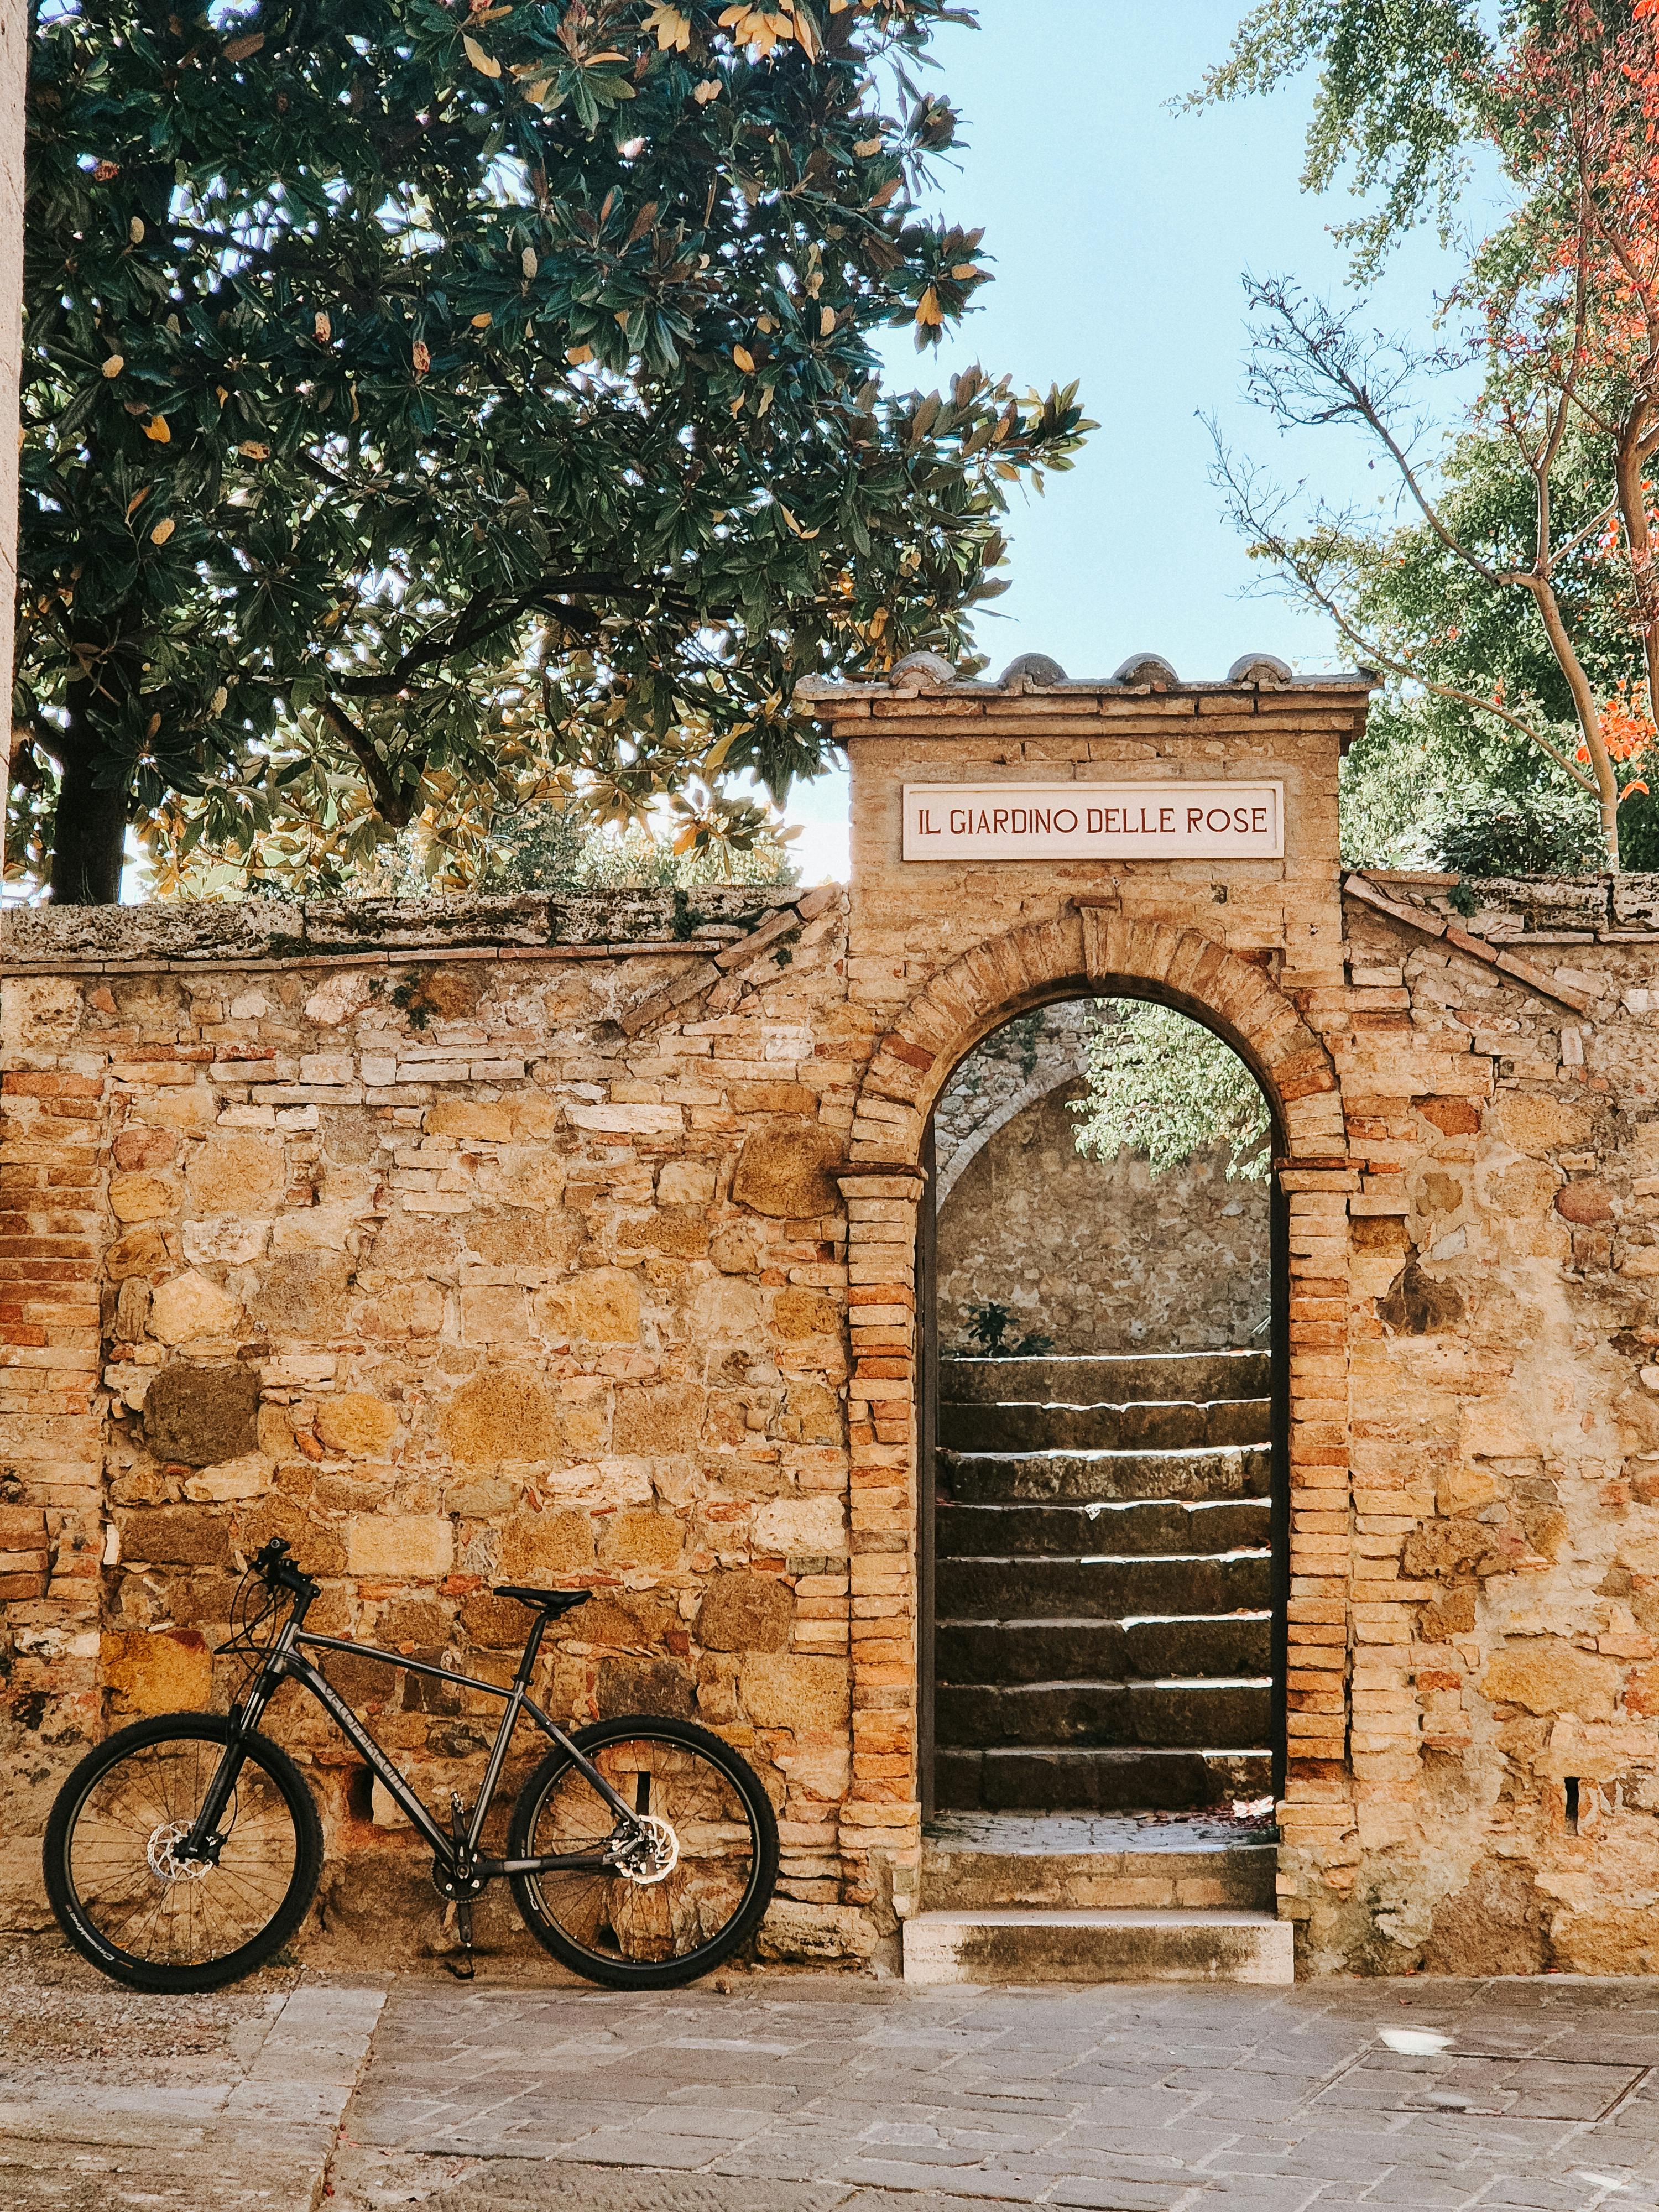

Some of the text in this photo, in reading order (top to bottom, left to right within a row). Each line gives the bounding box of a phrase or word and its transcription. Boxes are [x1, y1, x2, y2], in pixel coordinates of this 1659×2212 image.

[919, 807, 1267, 834] IL GIARDINO DELLE ROSE
